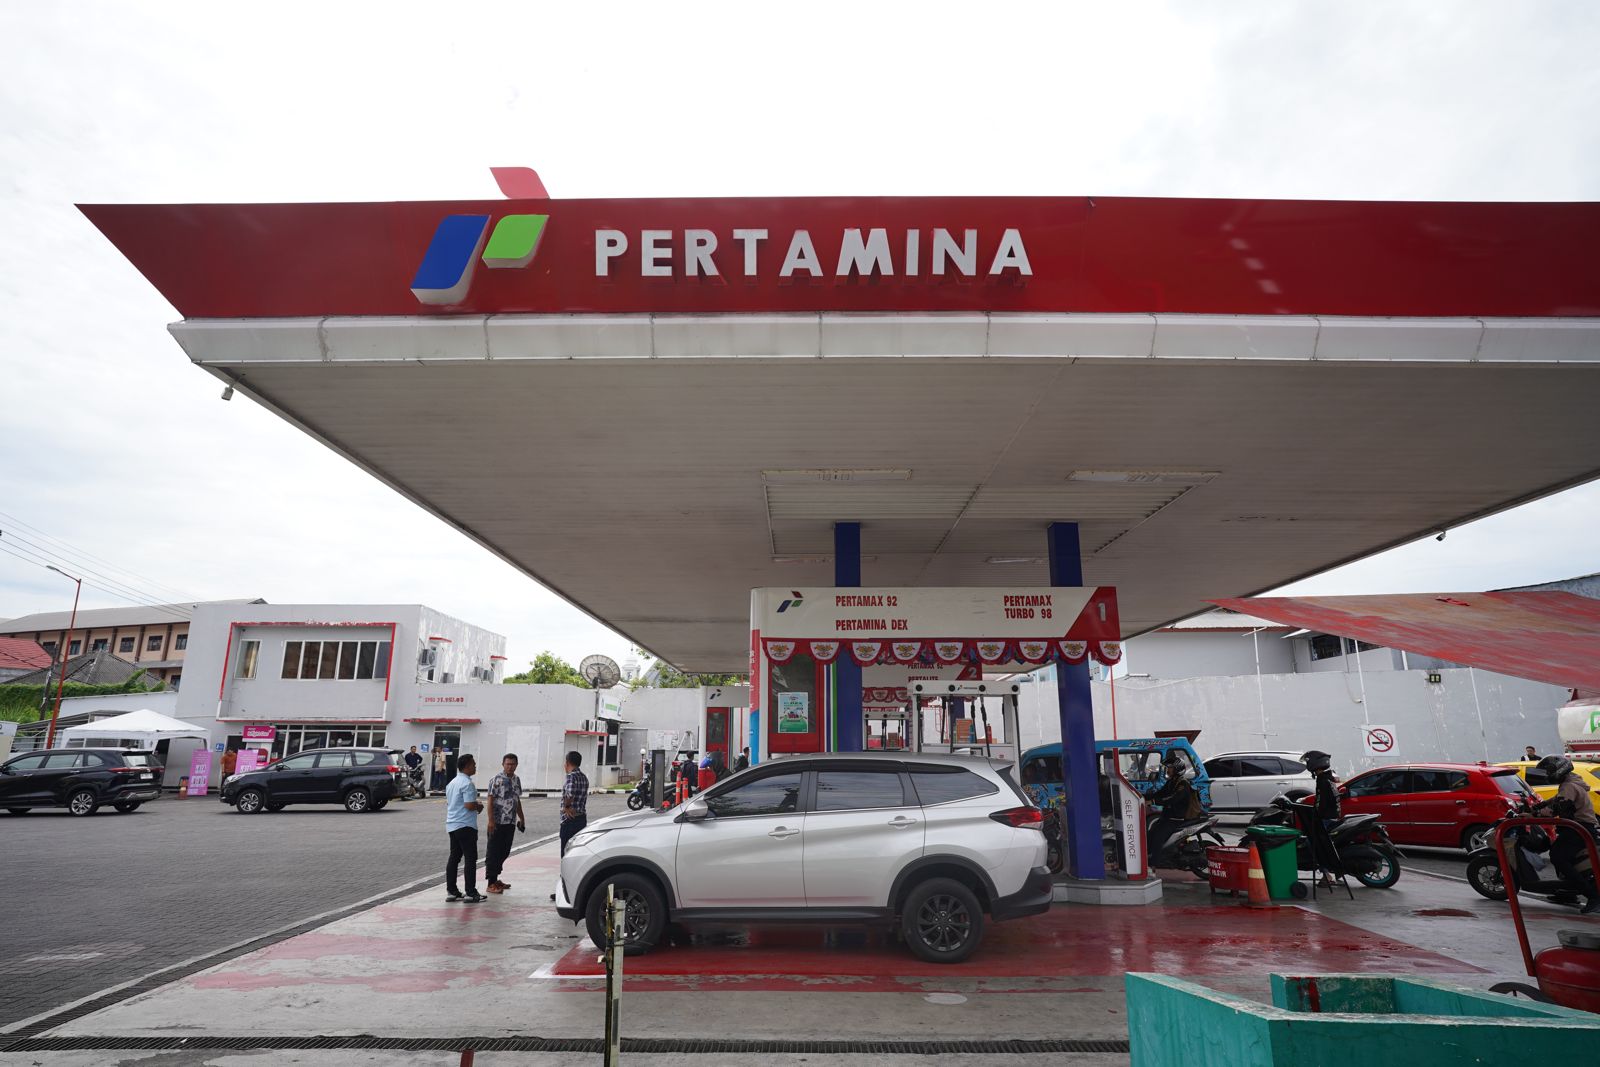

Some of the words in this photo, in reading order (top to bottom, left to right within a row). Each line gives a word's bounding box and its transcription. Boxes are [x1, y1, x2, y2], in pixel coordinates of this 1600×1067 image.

[594, 227, 1034, 278] PERTAMINA
[835, 595, 883, 606] PERTAMAX
[887, 596, 898, 606] 92
[1004, 595, 1052, 606] PERTAMAX
[1005, 608, 1034, 619] TURBO
[1041, 609, 1052, 619] 98
[1098, 602, 1107, 622] 1
[835, 619, 887, 631] PERTAMINA
[891, 619, 908, 630] DEX
[968, 667, 977, 679] 2
[1127, 824, 1136, 859] SERVICE
